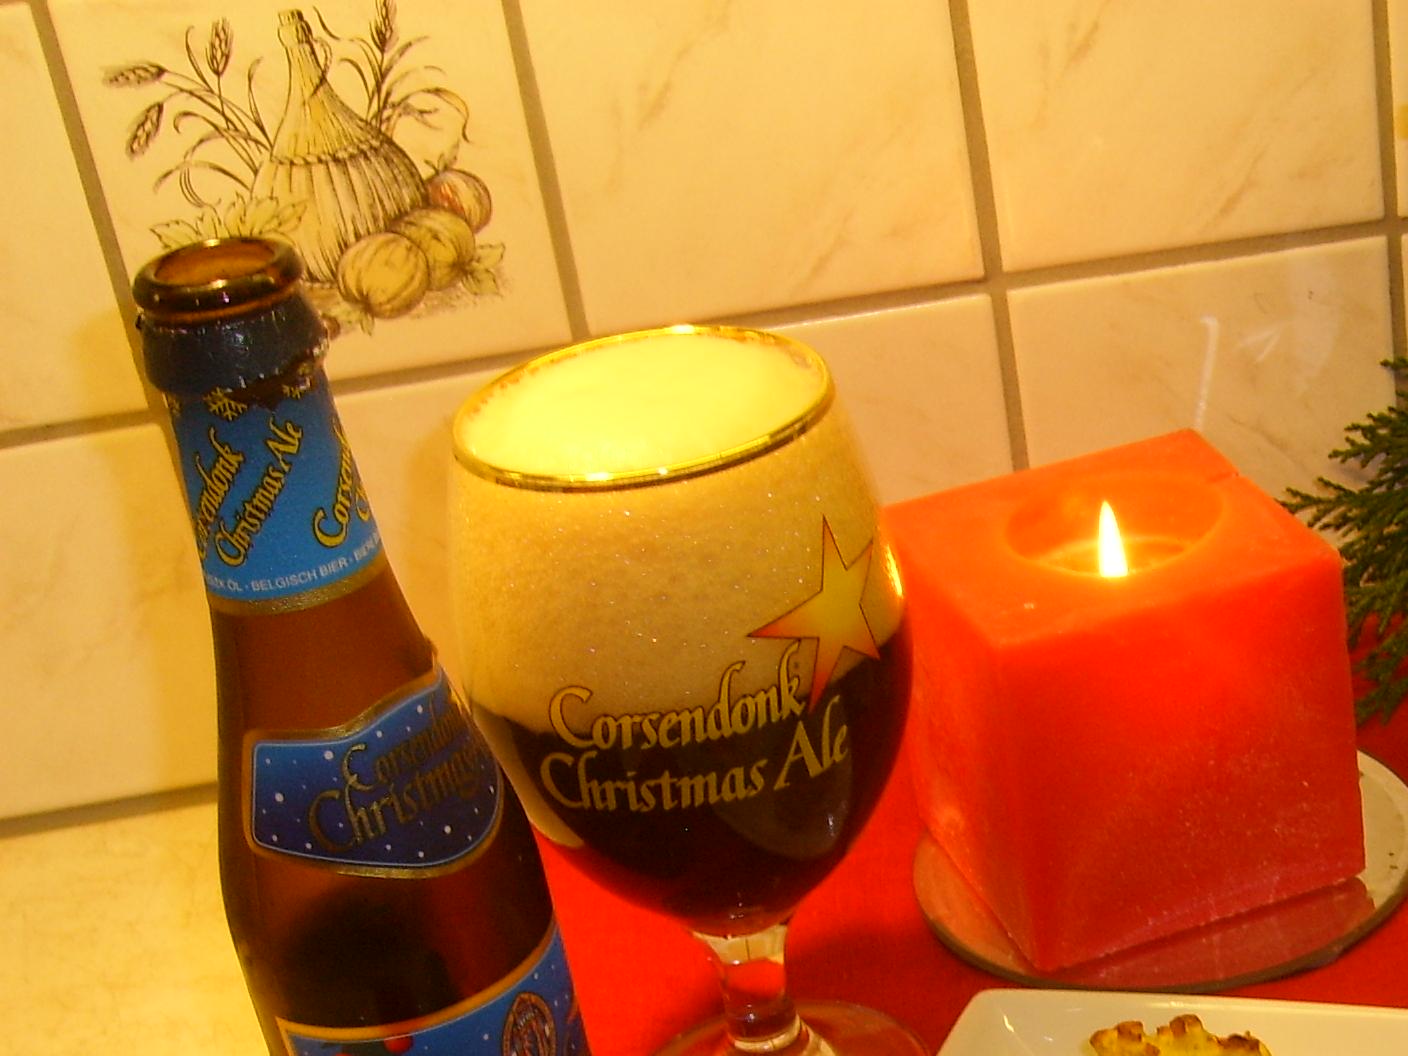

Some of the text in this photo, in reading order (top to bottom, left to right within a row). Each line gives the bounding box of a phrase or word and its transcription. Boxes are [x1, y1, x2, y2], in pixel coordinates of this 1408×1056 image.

[214, 414, 303, 568] Christmas Ale
[251, 568, 318, 592] BELGISCH
[320, 556, 349, 578] BIER
[549, 637, 806, 750] Corsendonk
[540, 694, 849, 813] Christmas Ale
